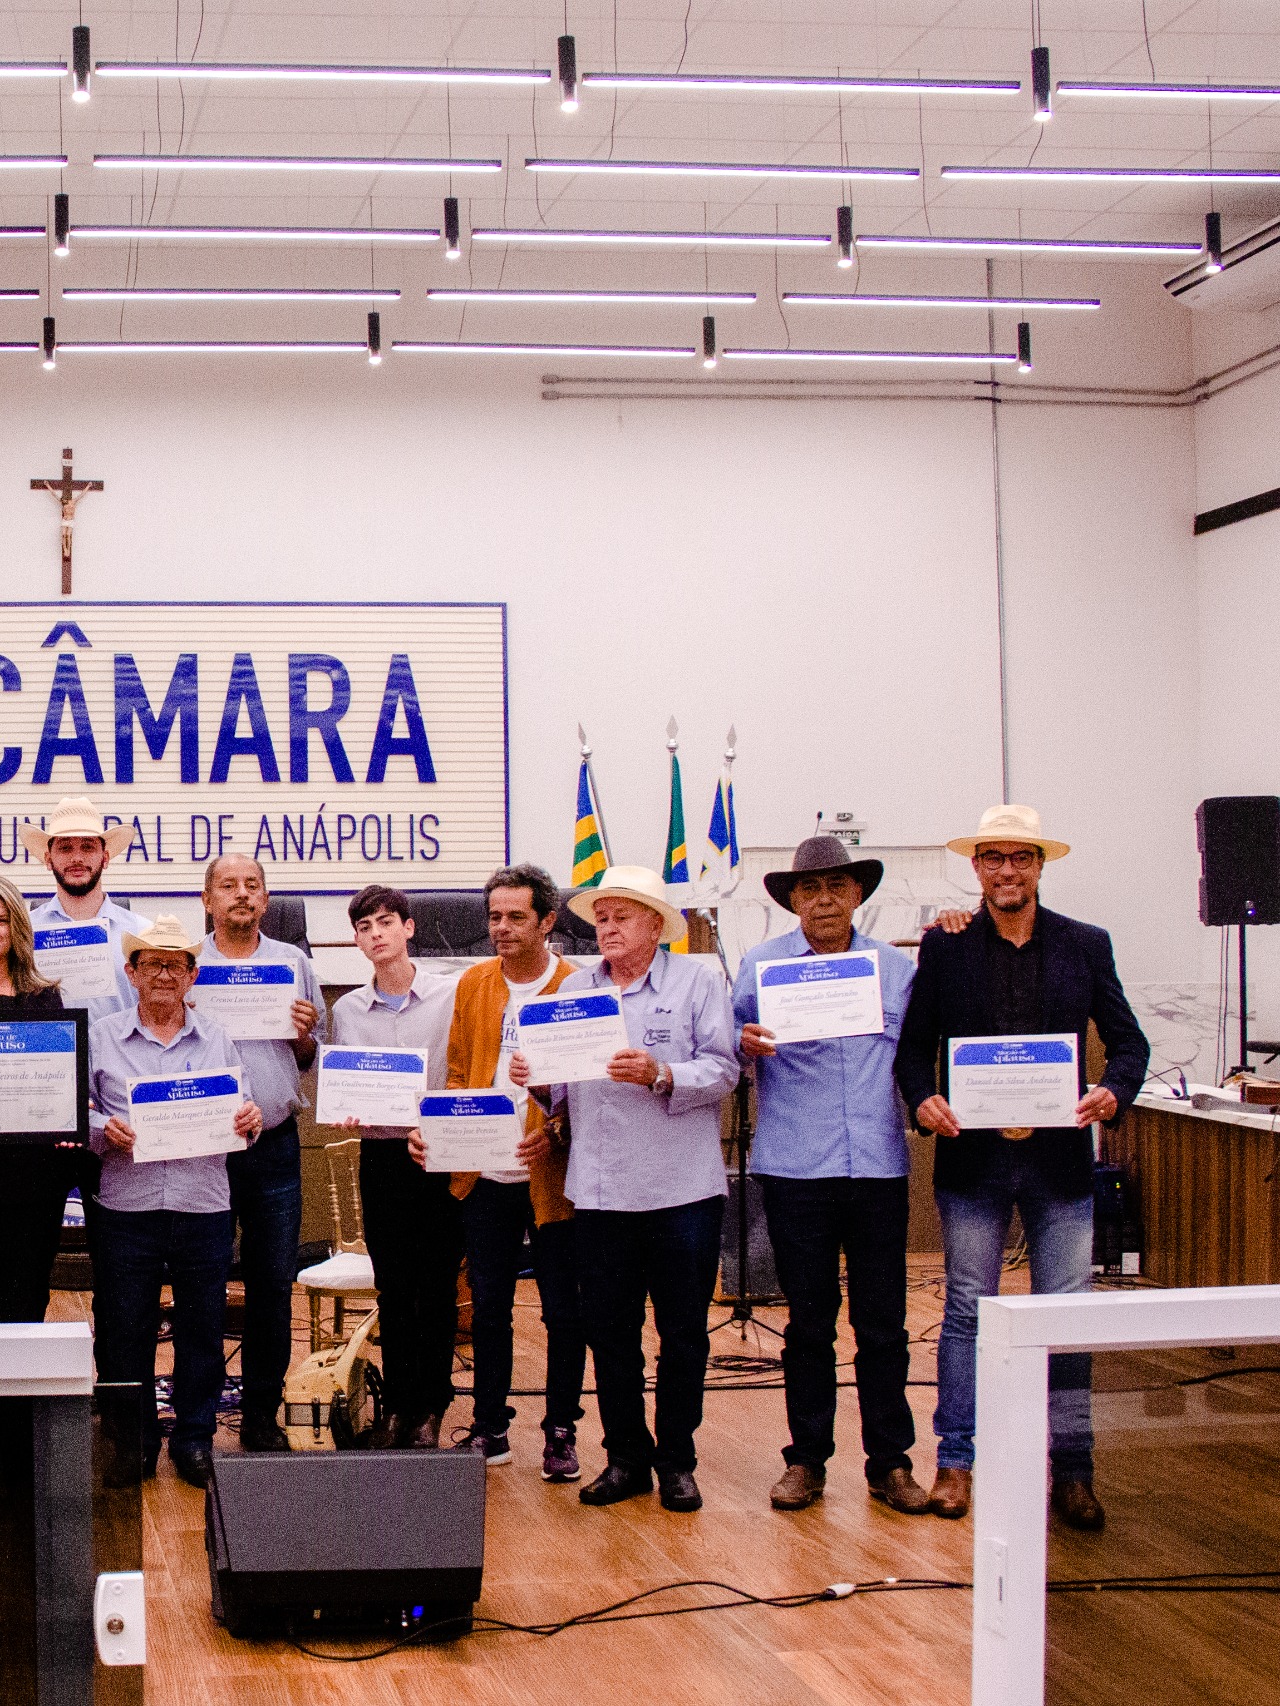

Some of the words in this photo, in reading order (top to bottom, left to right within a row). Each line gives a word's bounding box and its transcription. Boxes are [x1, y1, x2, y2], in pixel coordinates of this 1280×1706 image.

[191, 814, 234, 861] DE
[254, 803, 440, 862] ANÁPOLIS
[20, 1072, 28, 1080] de
[30, 1070, 66, 1082] Anápolis
